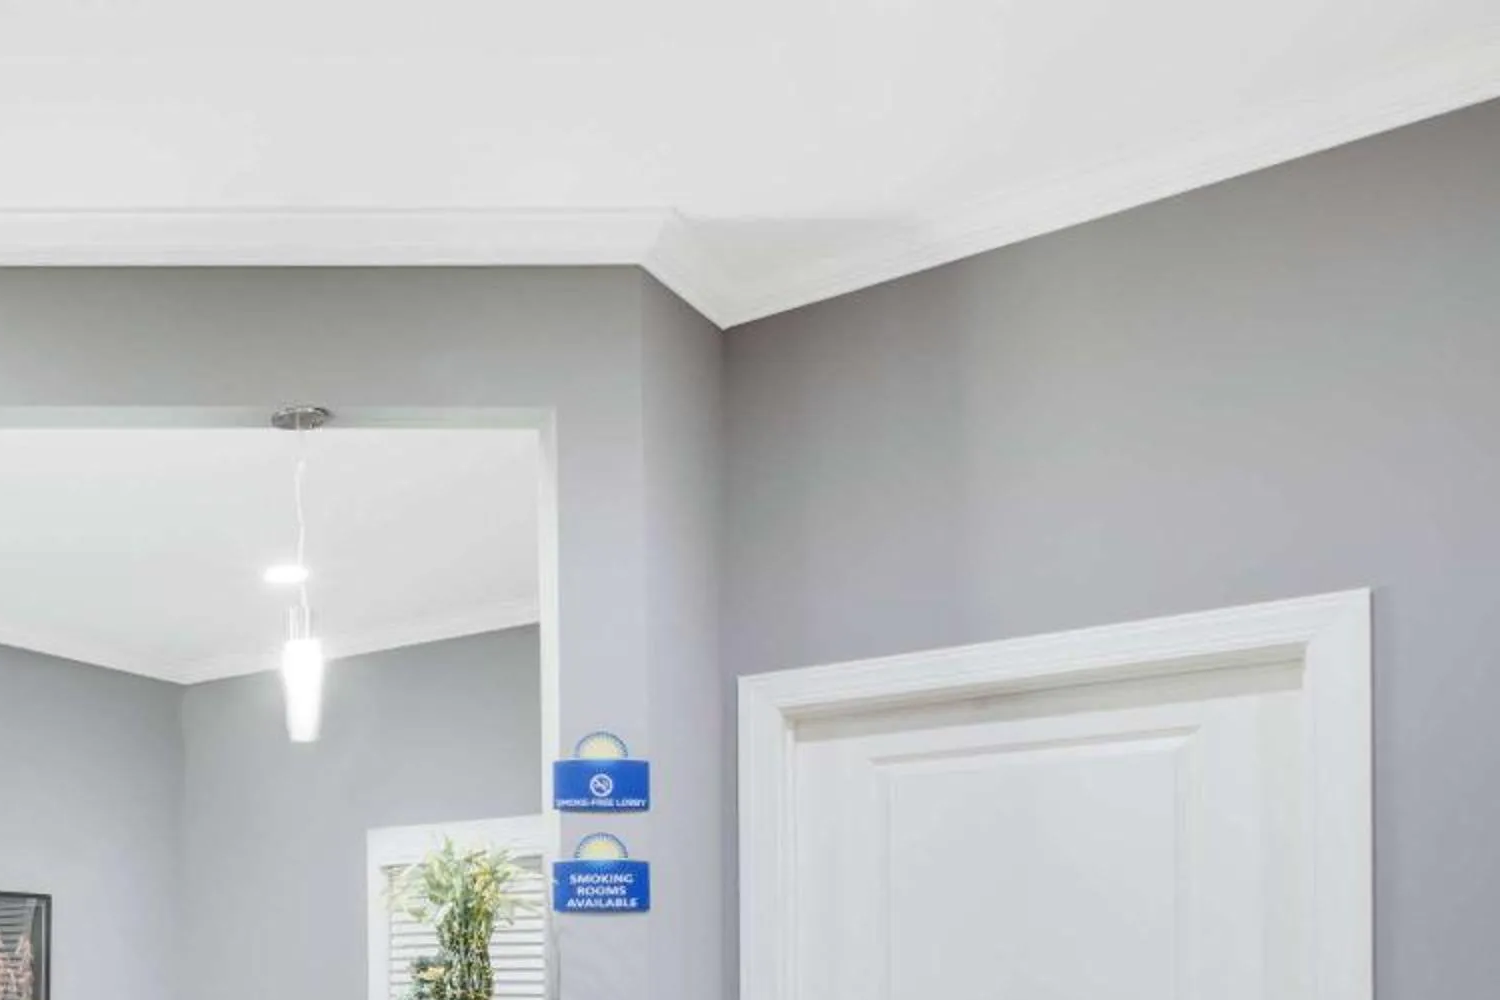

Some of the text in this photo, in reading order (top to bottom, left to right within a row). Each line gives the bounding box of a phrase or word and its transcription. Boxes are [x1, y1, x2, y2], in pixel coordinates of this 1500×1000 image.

[556, 798, 647, 807] SMOKE-FREE LOBBY
[569, 873, 634, 884] SMOKING
[576, 886, 627, 896] ROOMS
[566, 897, 639, 908] AVAILABLE
